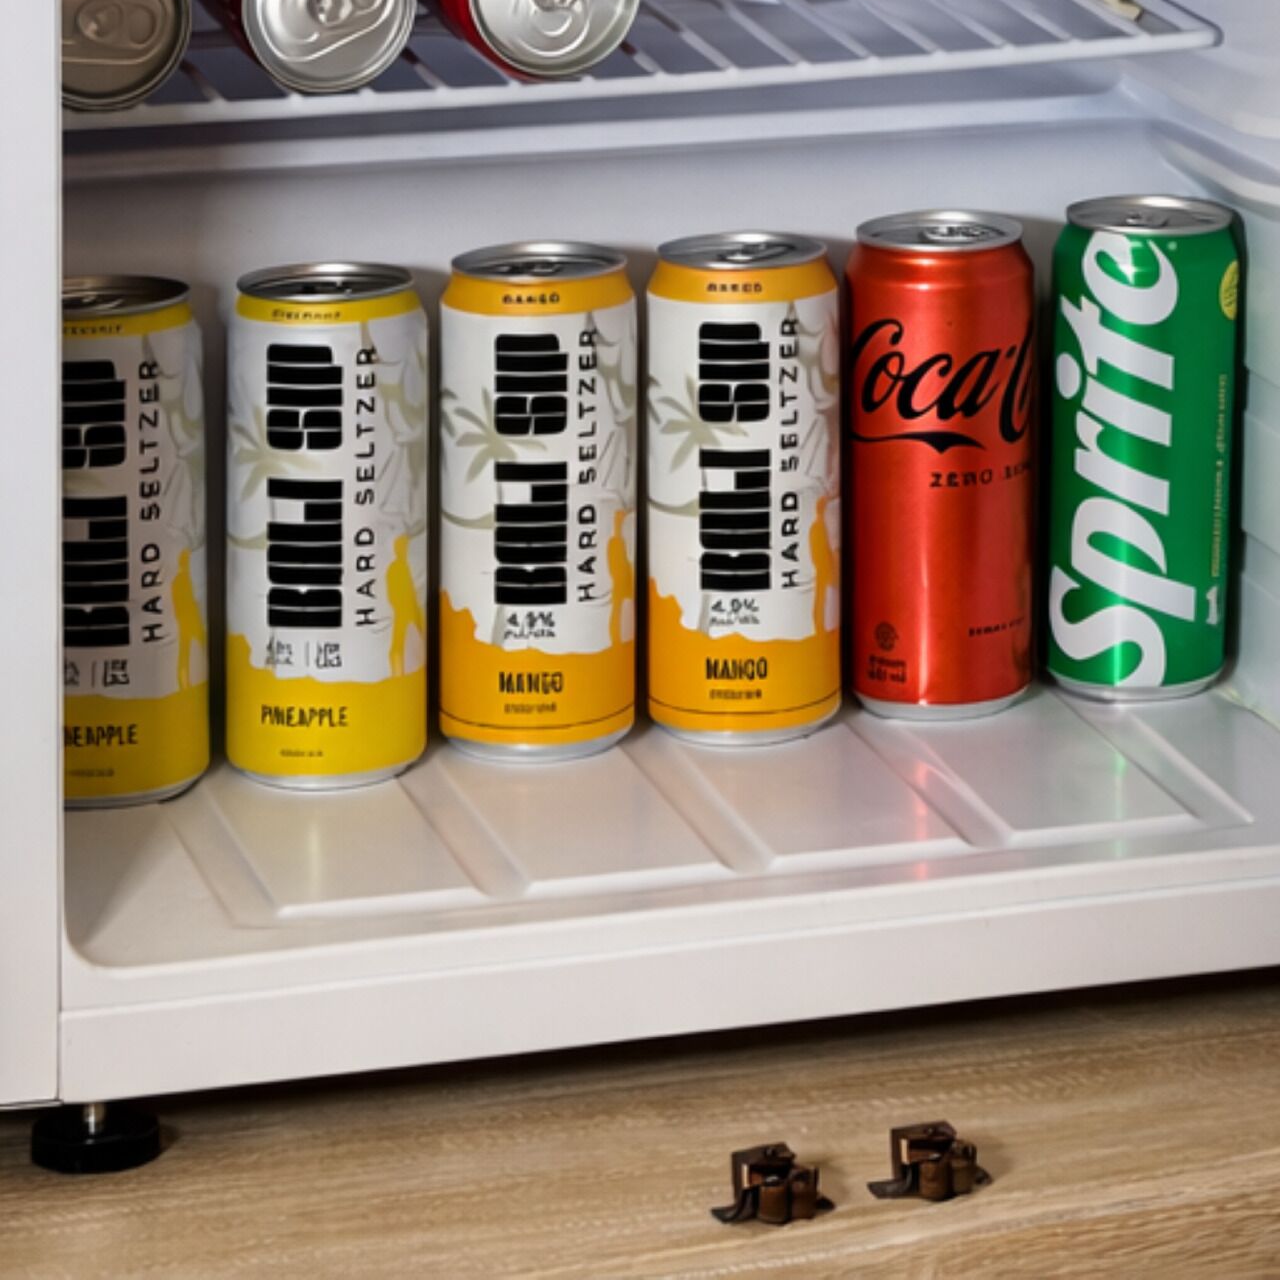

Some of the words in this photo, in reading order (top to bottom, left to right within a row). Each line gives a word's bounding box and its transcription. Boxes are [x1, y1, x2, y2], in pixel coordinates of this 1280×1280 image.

[138, 360, 161, 521] SELTZER
[355, 346, 378, 506] SELTZER
[577, 328, 598, 485] SELTZER
[779, 317, 800, 472] SELTZER
[1048, 230, 1197, 687] Sprite
[355, 526, 377, 626] HARD
[577, 504, 598, 602] HARD
[780, 491, 799, 589] HARD
[141, 542, 164, 642] HARD
[261, 704, 348, 728] PINEAPPLE
[499, 671, 565, 695] MANGO
[705, 657, 768, 681] MANGO
